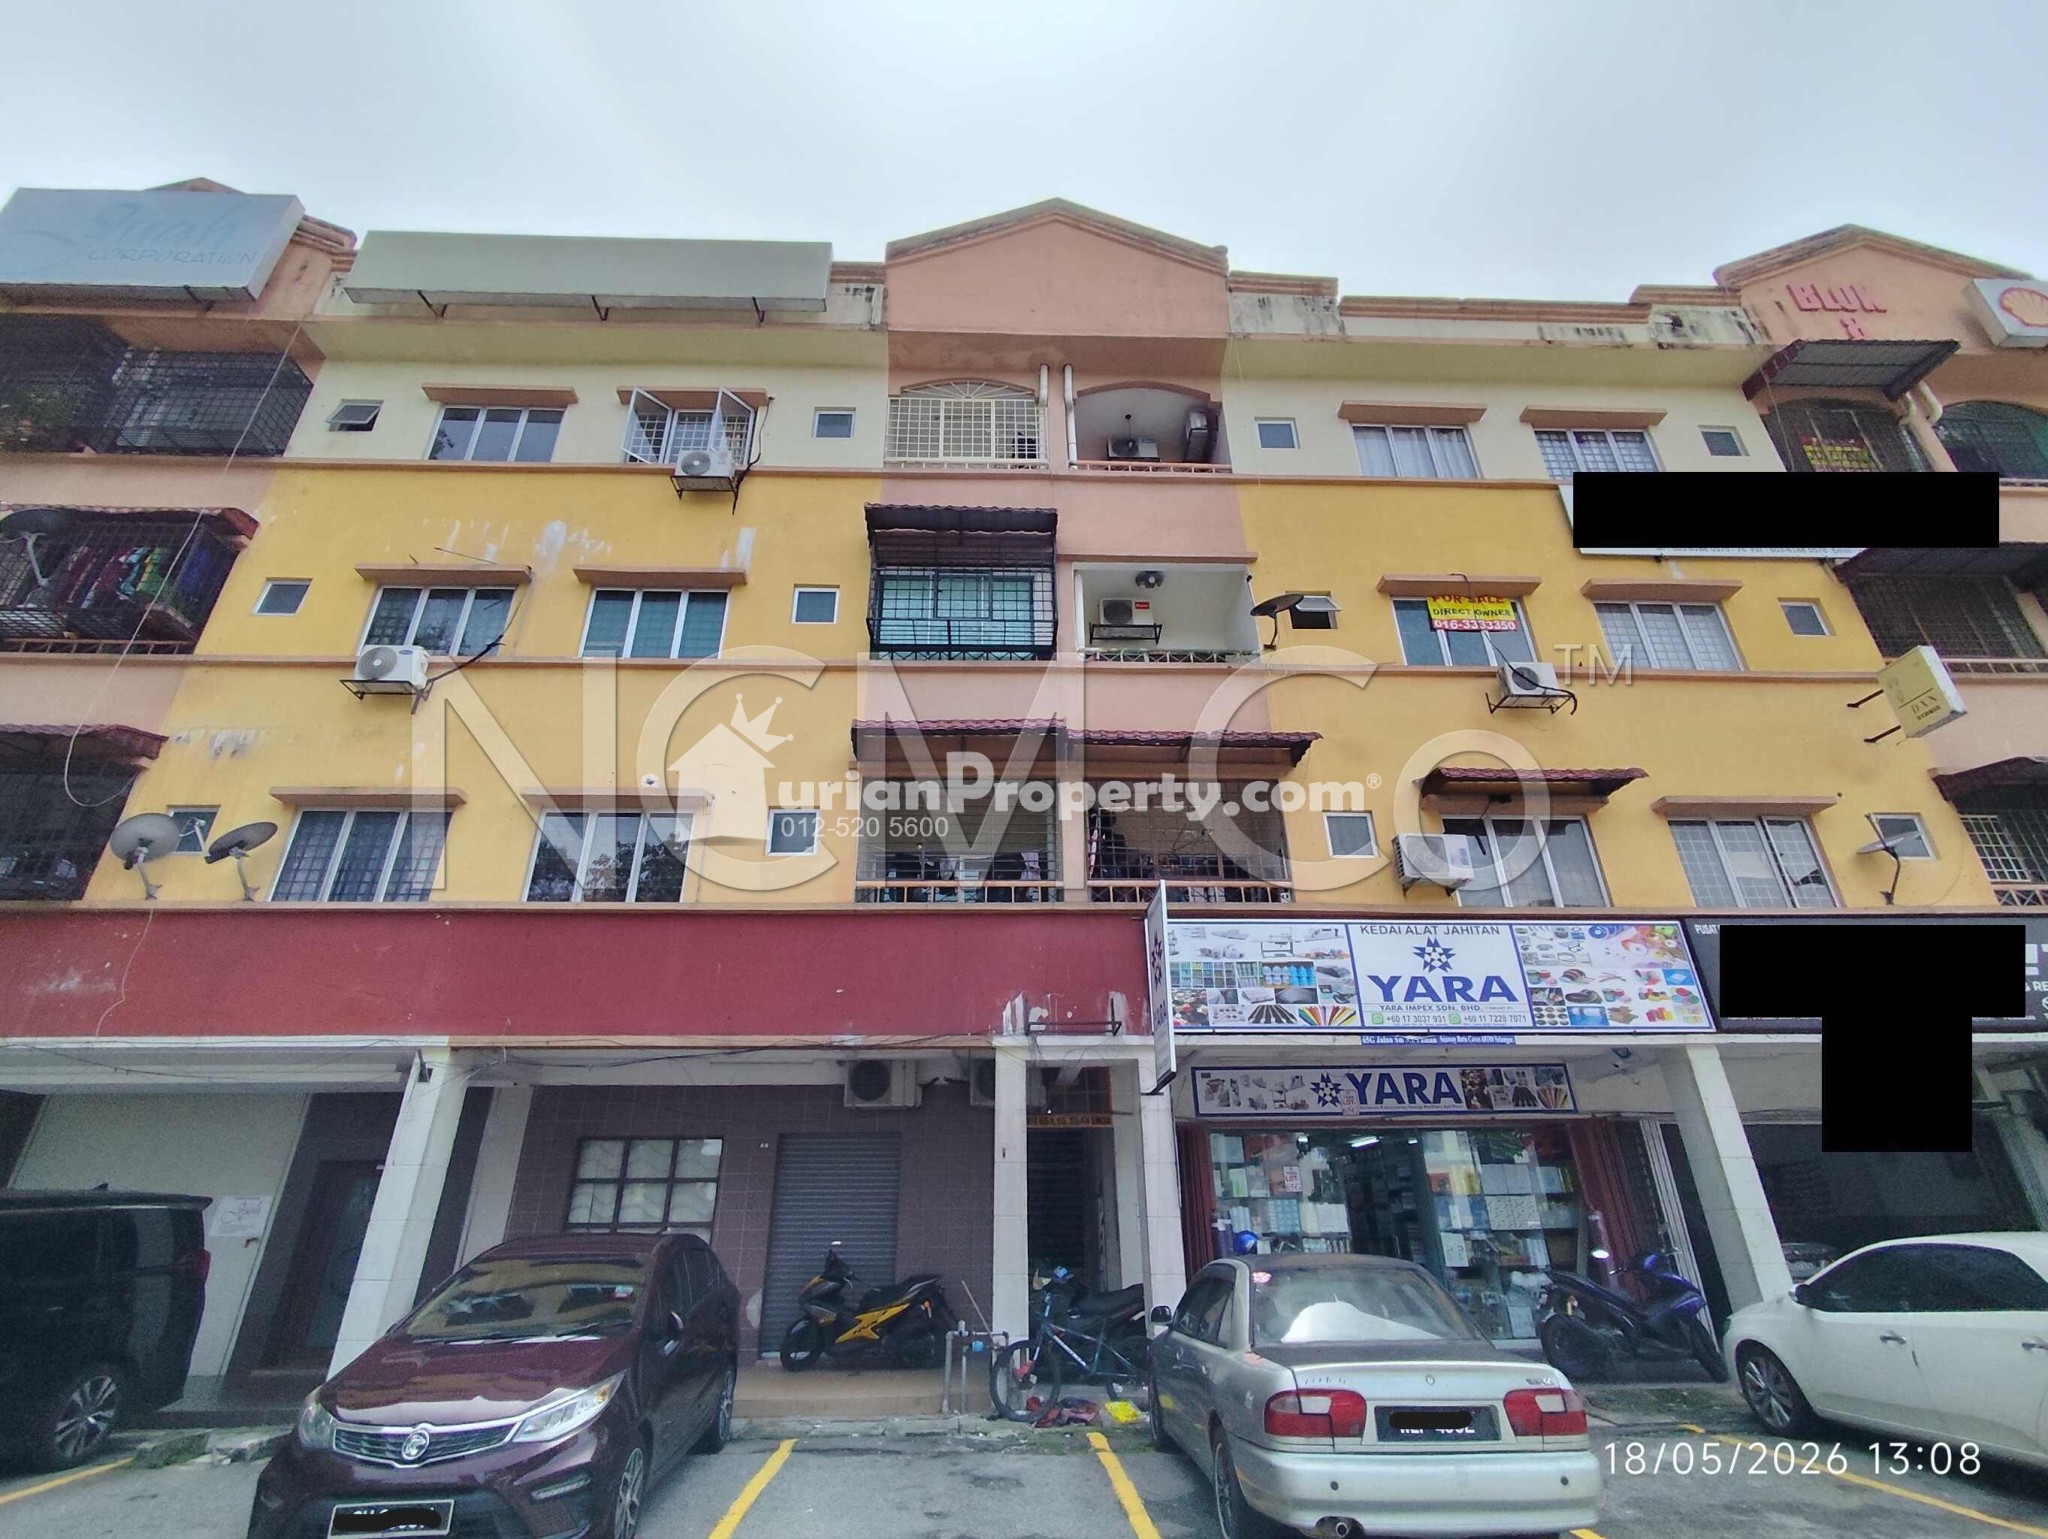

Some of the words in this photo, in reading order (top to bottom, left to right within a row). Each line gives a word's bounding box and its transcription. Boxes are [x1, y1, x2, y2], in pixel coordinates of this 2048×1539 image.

[87, 249, 257, 264] CORPORATION
[1474, 608, 1511, 616] OWNER
[1360, 925, 1402, 935] KEDAI
[1405, 925, 1438, 935] ALAT
[1443, 925, 1500, 936] JAHITAN
[1694, 924, 1718, 934] PUSAT
[1367, 975, 1519, 1002] YARA
[1402, 1015, 1410, 1023] 17
[1344, 1072, 1463, 1105] YARA
